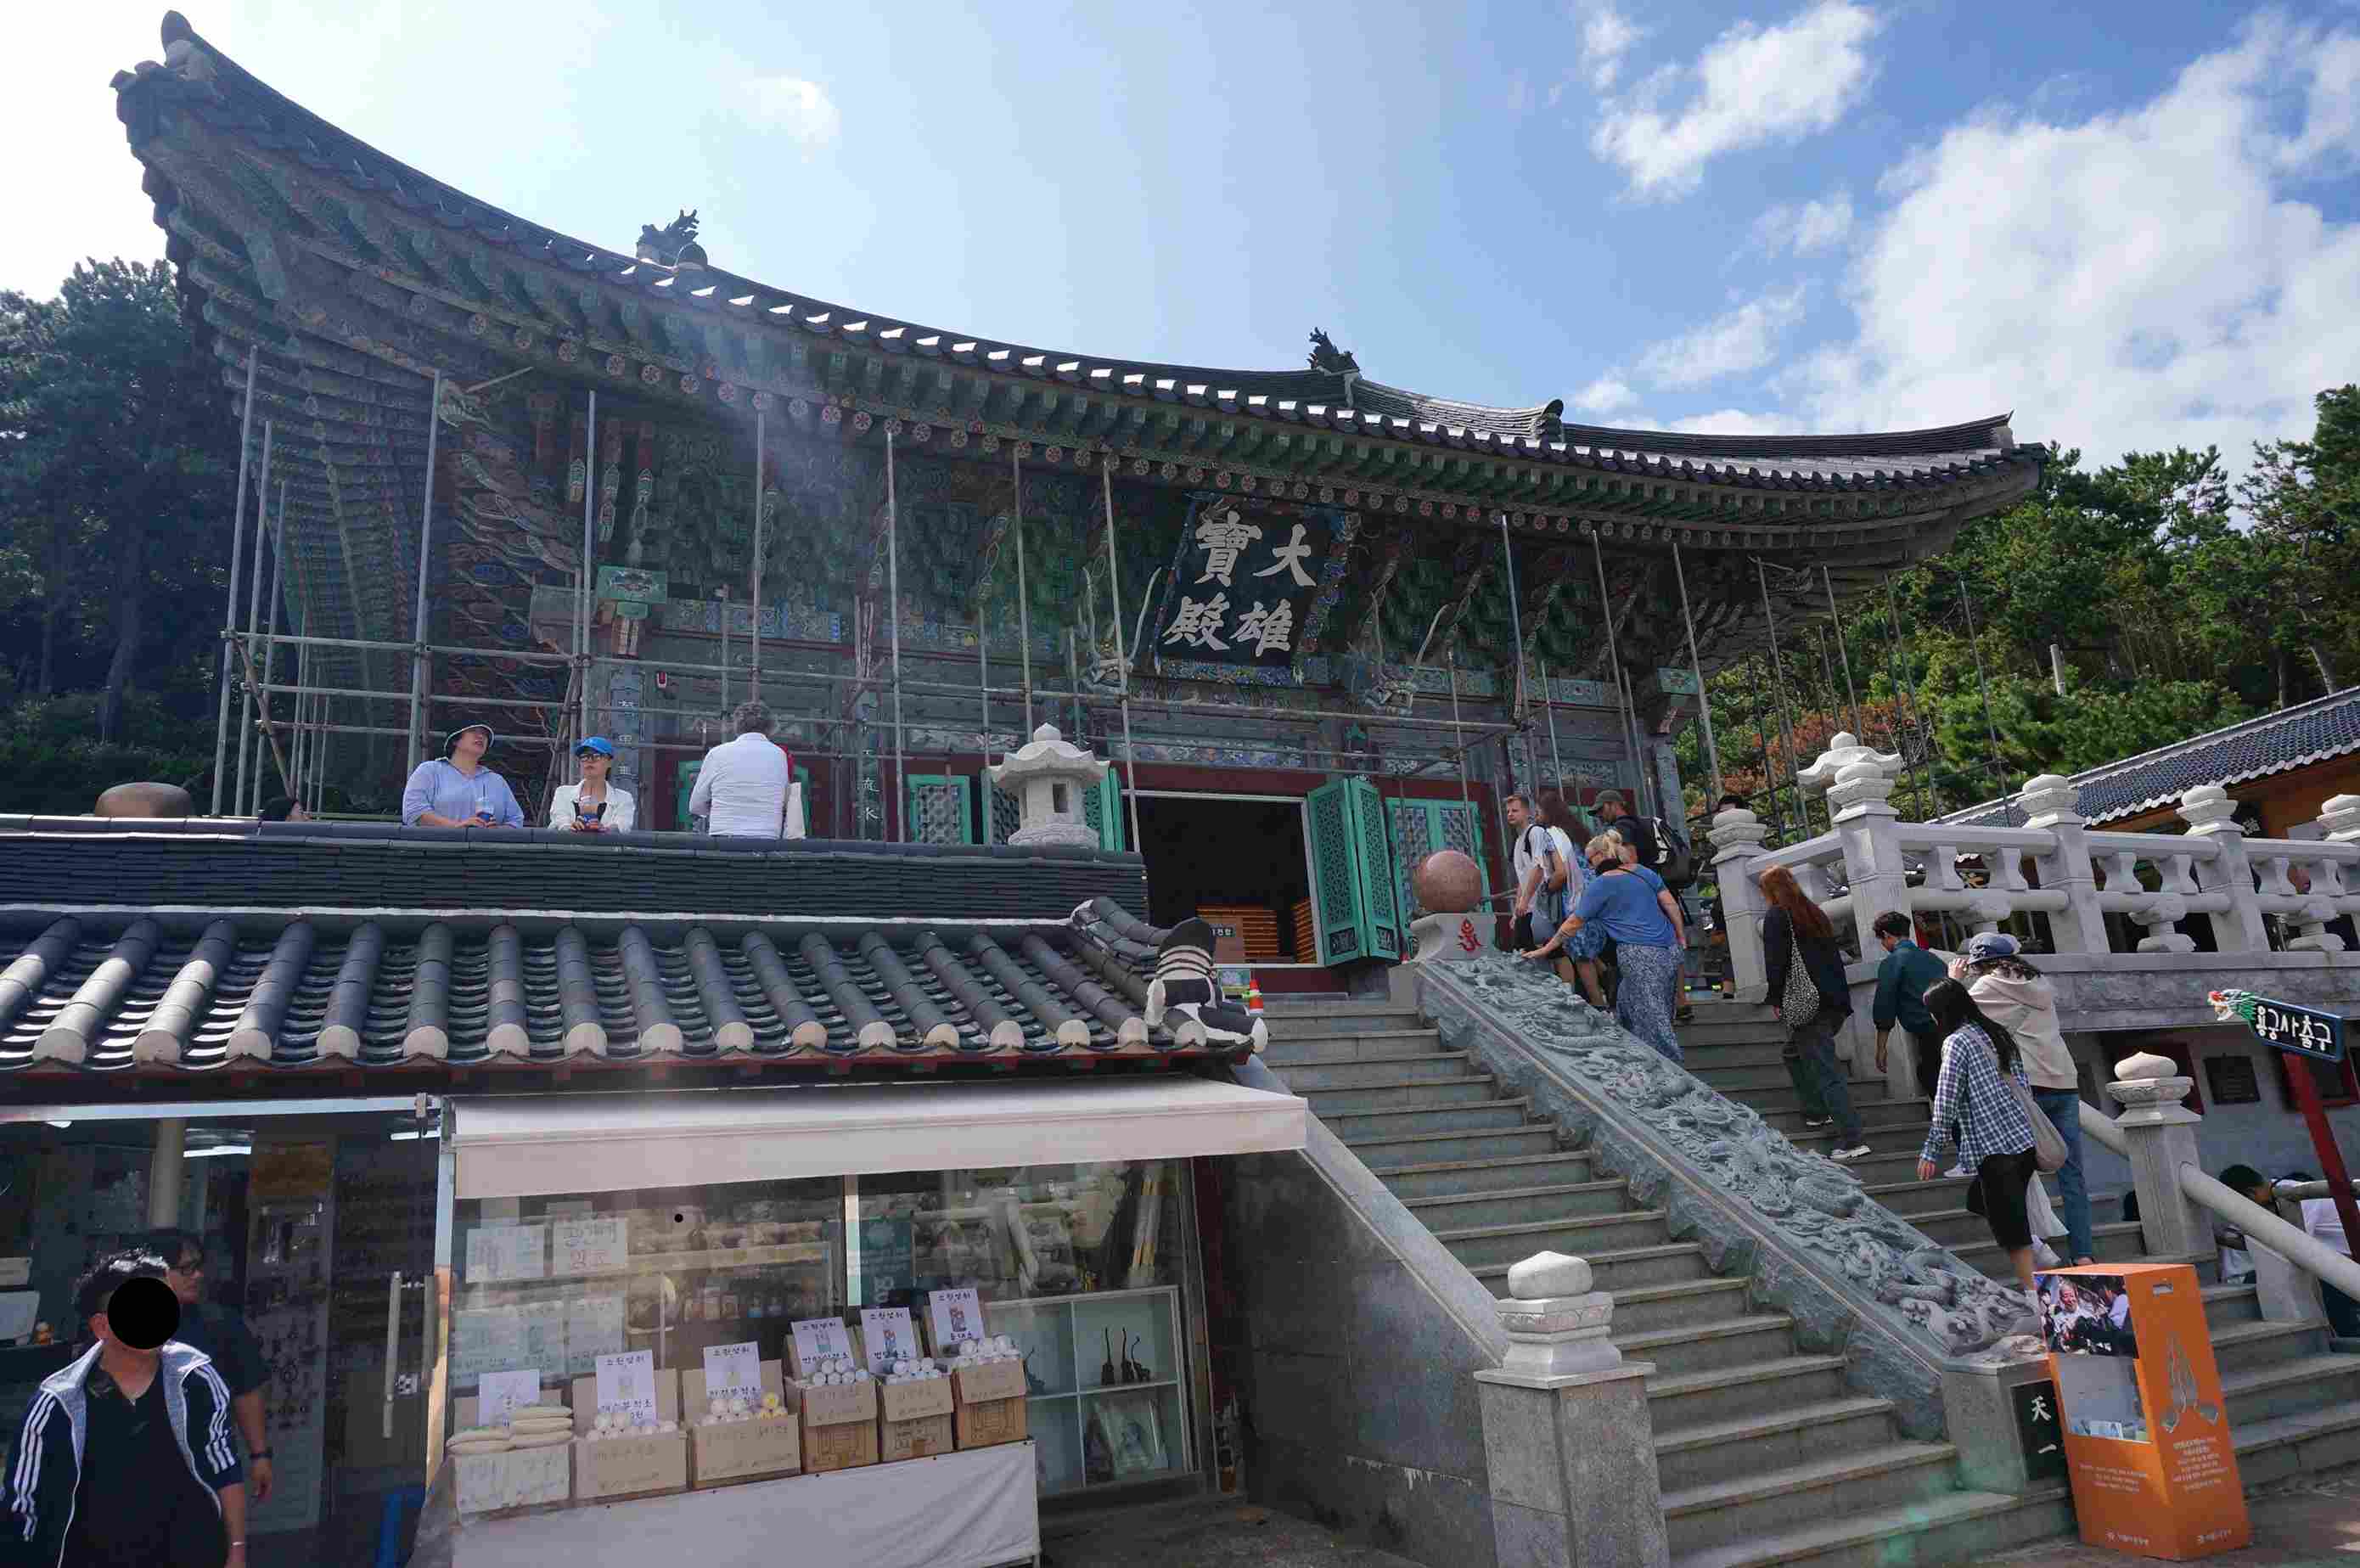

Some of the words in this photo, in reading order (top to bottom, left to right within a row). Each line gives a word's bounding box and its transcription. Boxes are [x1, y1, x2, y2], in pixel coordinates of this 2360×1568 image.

[2255, 1005, 2333, 1051] 용궁사출구
[713, 1346, 750, 1357] 소원성취
[606, 1355, 645, 1366] 소원성취
